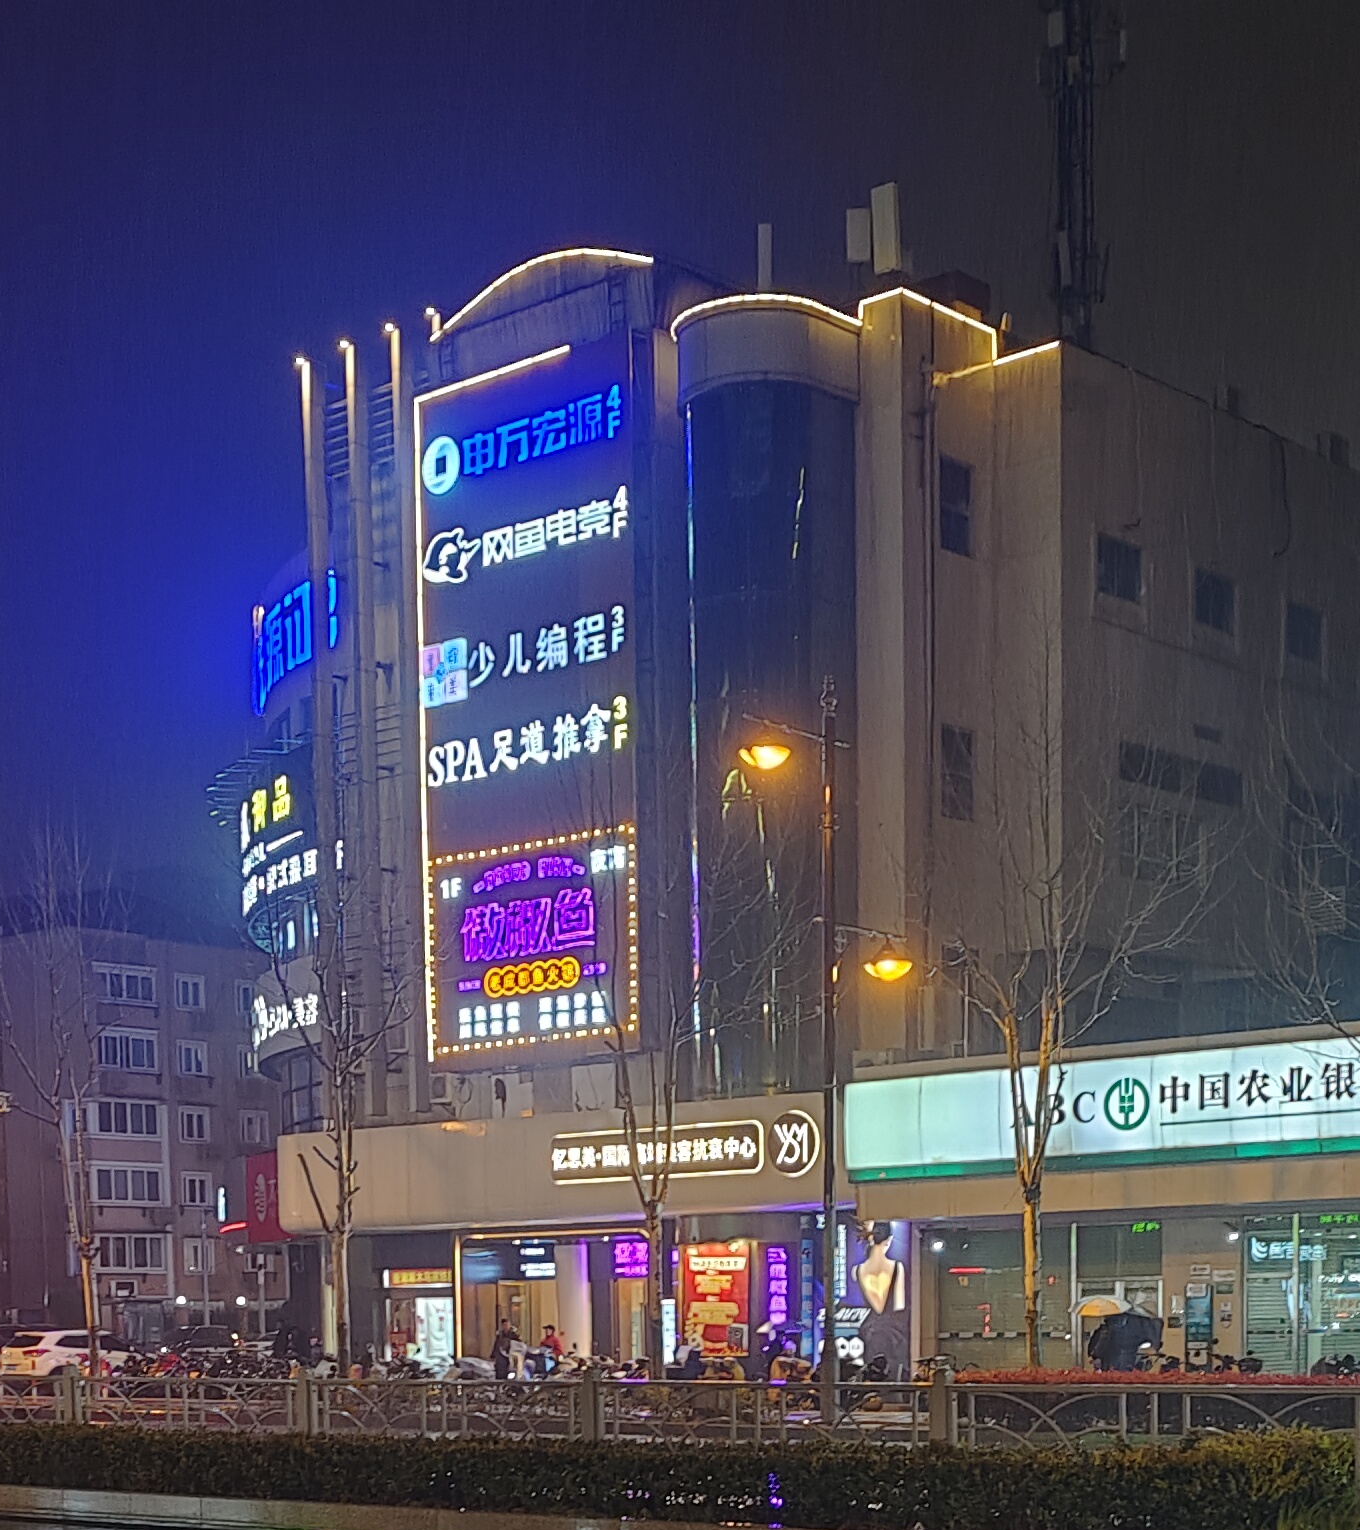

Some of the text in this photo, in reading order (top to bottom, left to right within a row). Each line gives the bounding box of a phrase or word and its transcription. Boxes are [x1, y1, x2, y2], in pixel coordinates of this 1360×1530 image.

[462, 394, 603, 477] 申万宏源
[606, 384, 622, 439] 4F
[482, 499, 613, 568] 网鱼电竞
[613, 484, 629, 541] 4F
[468, 612, 608, 689] 少儿编程
[610, 604, 625, 653] 3F
[612, 695, 629, 751] 3F
